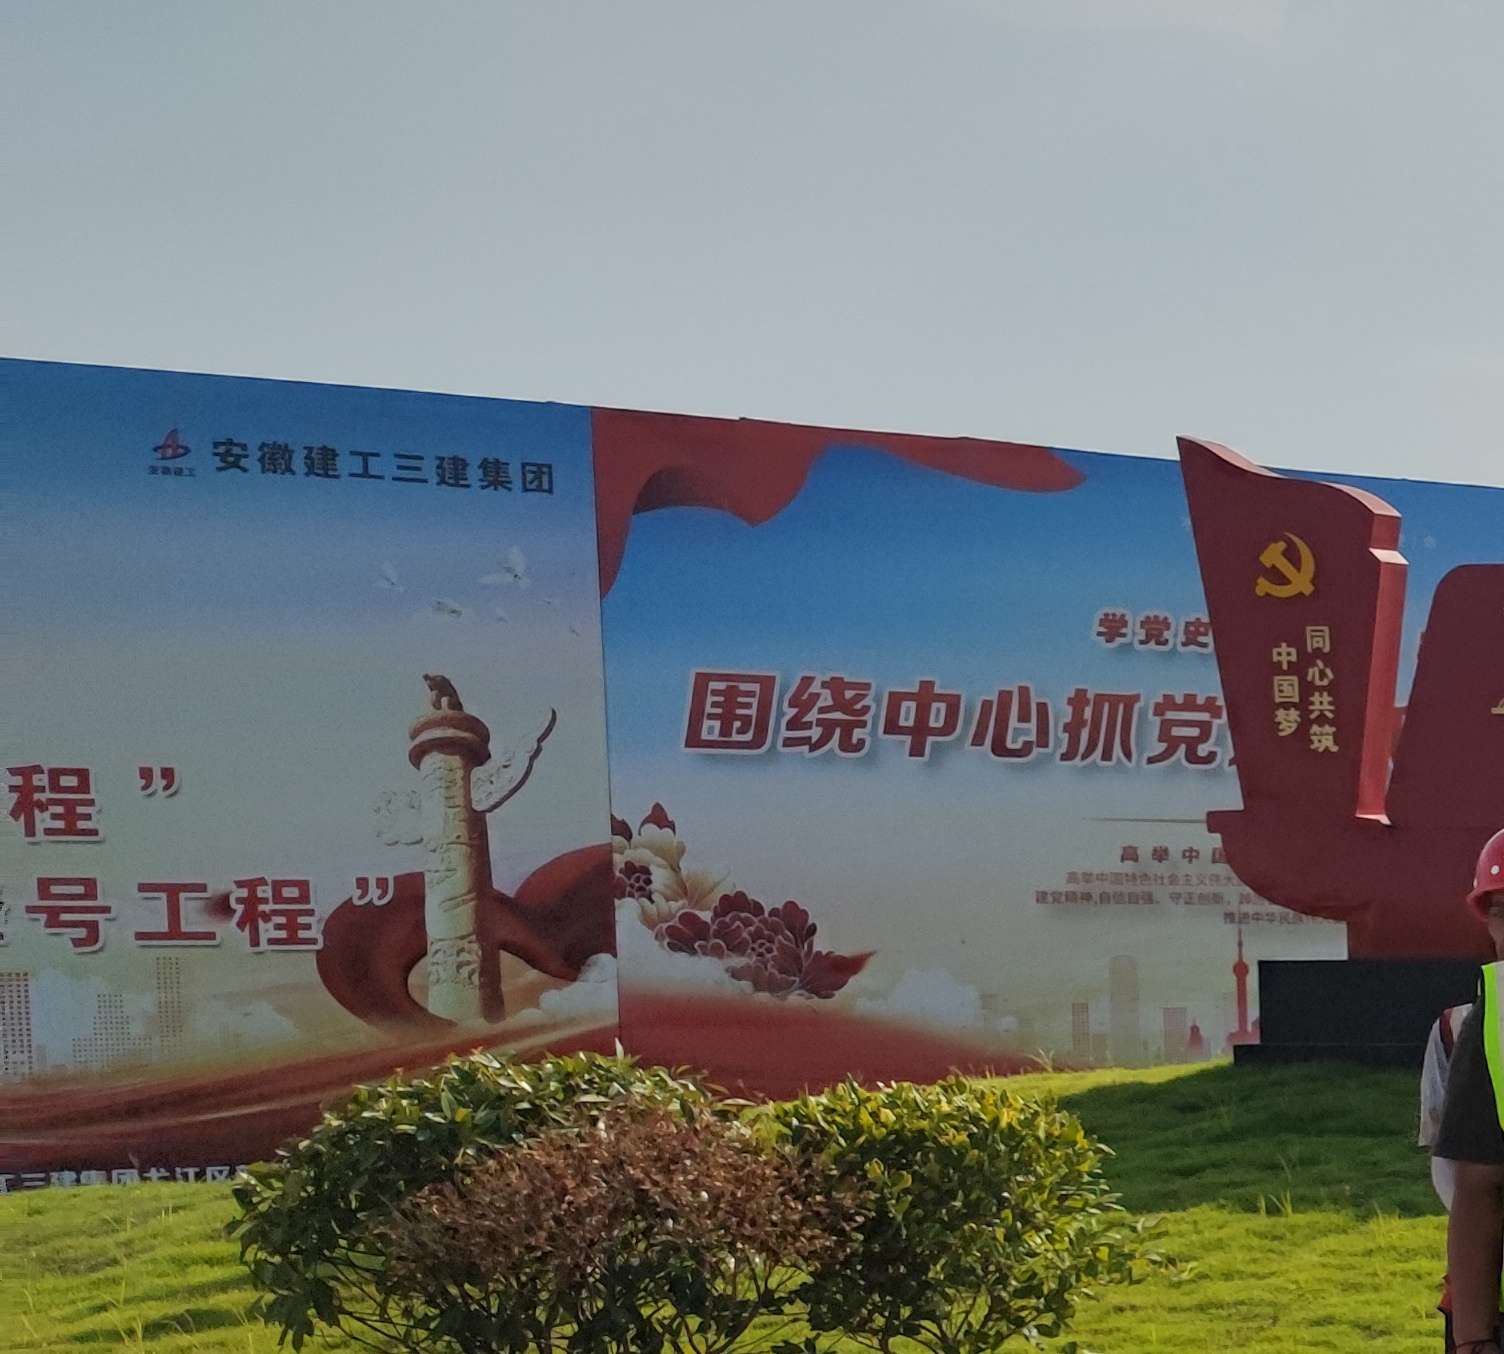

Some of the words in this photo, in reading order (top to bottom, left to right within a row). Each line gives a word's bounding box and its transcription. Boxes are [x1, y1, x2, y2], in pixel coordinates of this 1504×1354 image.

[211, 437, 555, 495] 安徽建工三建集团
[685, 672, 1237, 767] 围绕中心抓党
[1272, 642, 1301, 736] 中国梦
[1305, 626, 1339, 753] 同心共筑
